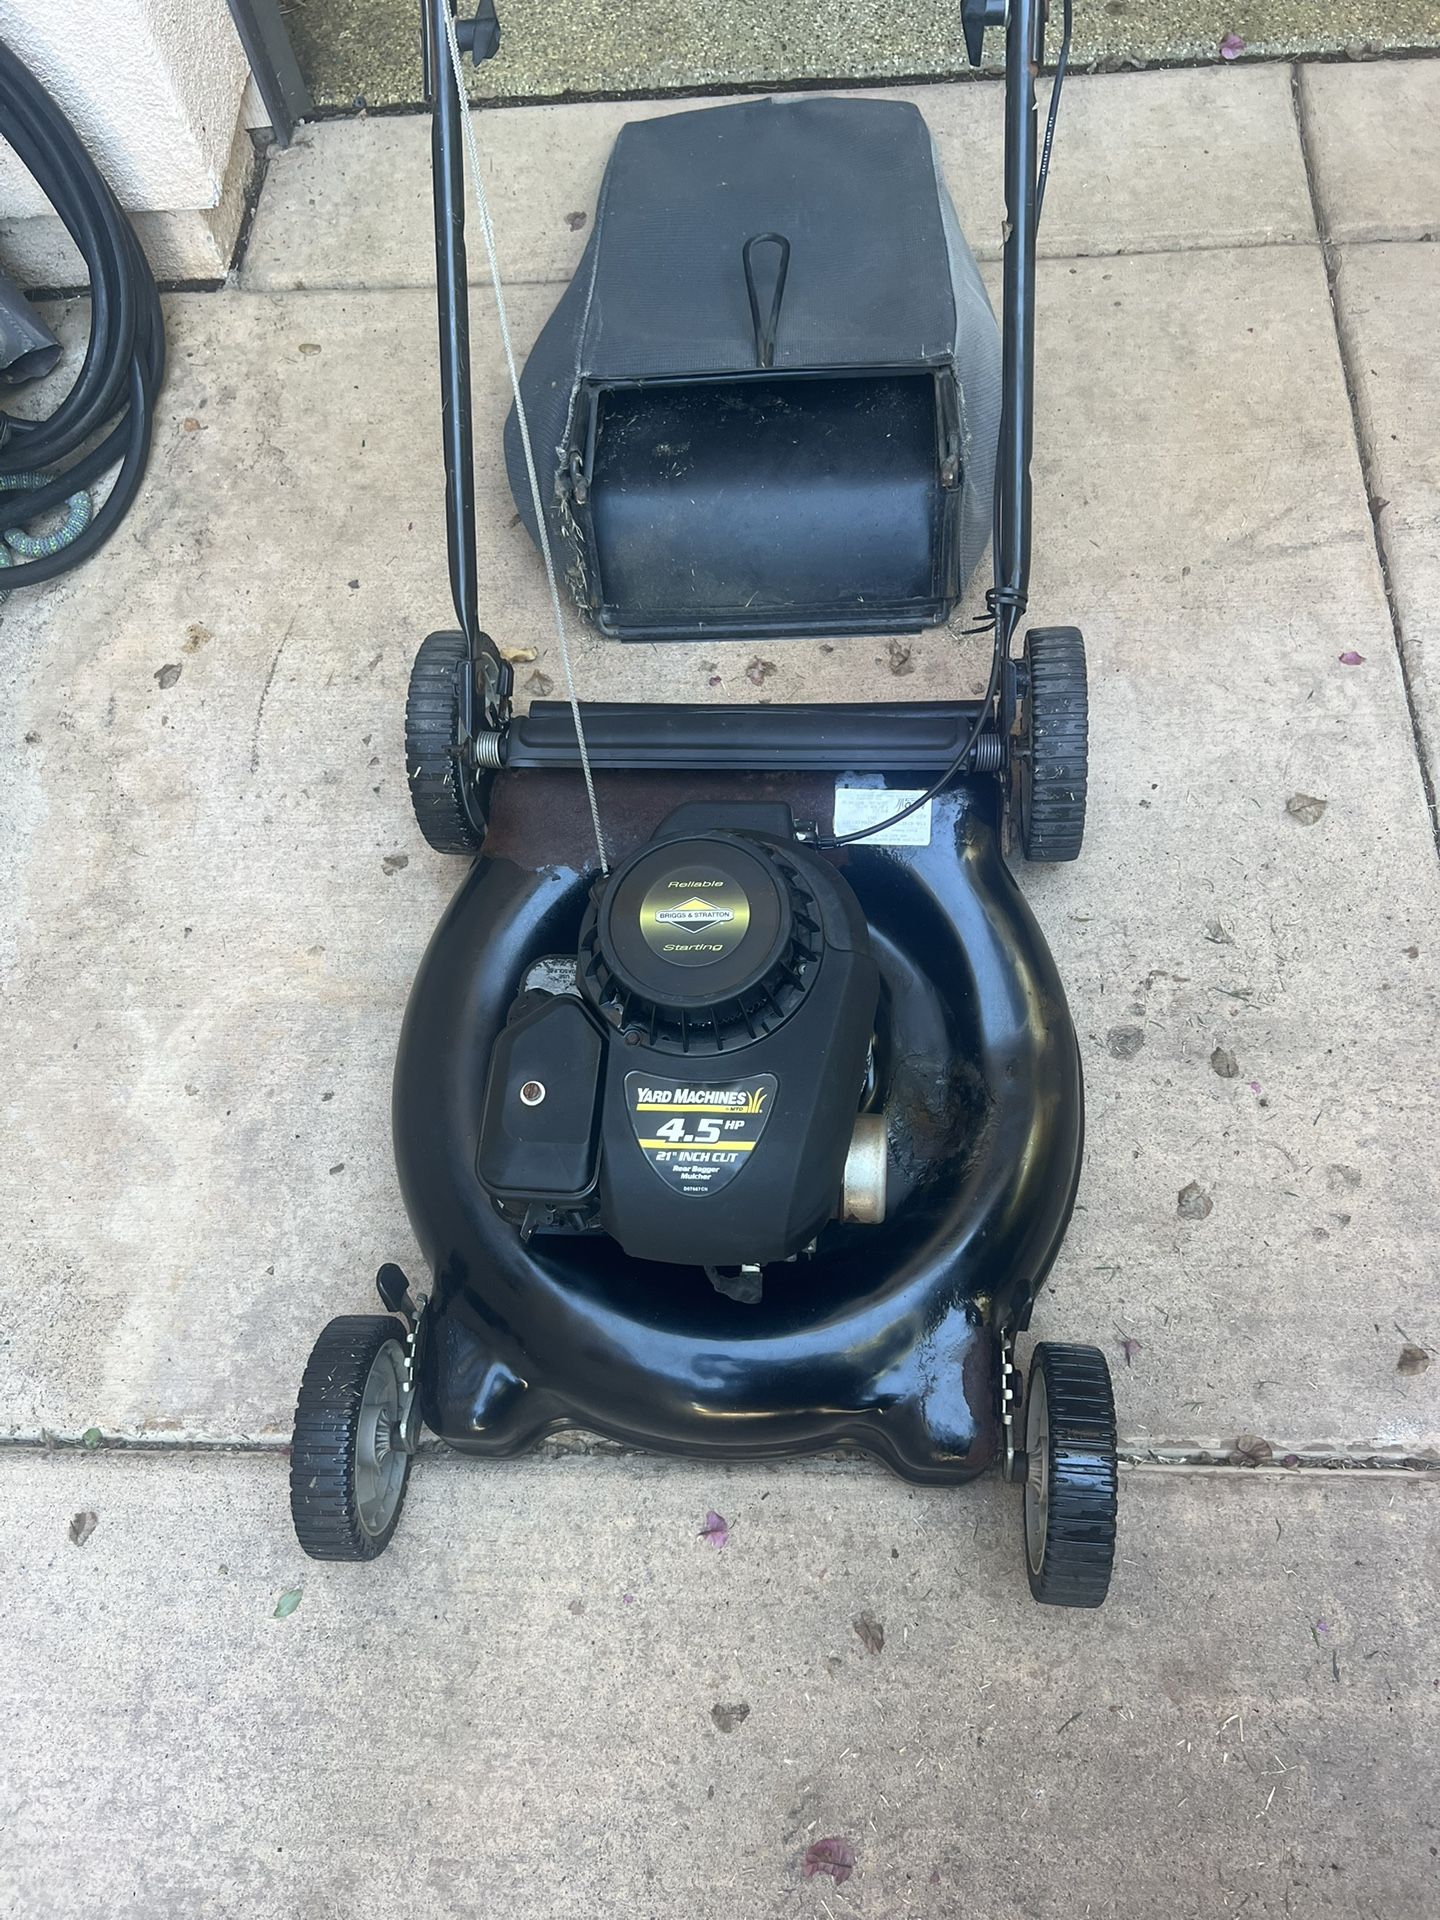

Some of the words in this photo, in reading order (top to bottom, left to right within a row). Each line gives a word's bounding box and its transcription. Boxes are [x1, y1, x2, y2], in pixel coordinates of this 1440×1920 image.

[663, 943, 723, 951] Starting
[637, 1088, 672, 1103] YARD
[673, 1089, 746, 1105] MACHINES
[656, 1118, 723, 1143] 4.5
[724, 1120, 745, 1130] HP
[656, 1152, 677, 1160] 21"
[679, 1152, 710, 1162] INCH
[712, 1153, 738, 1162] CUT
